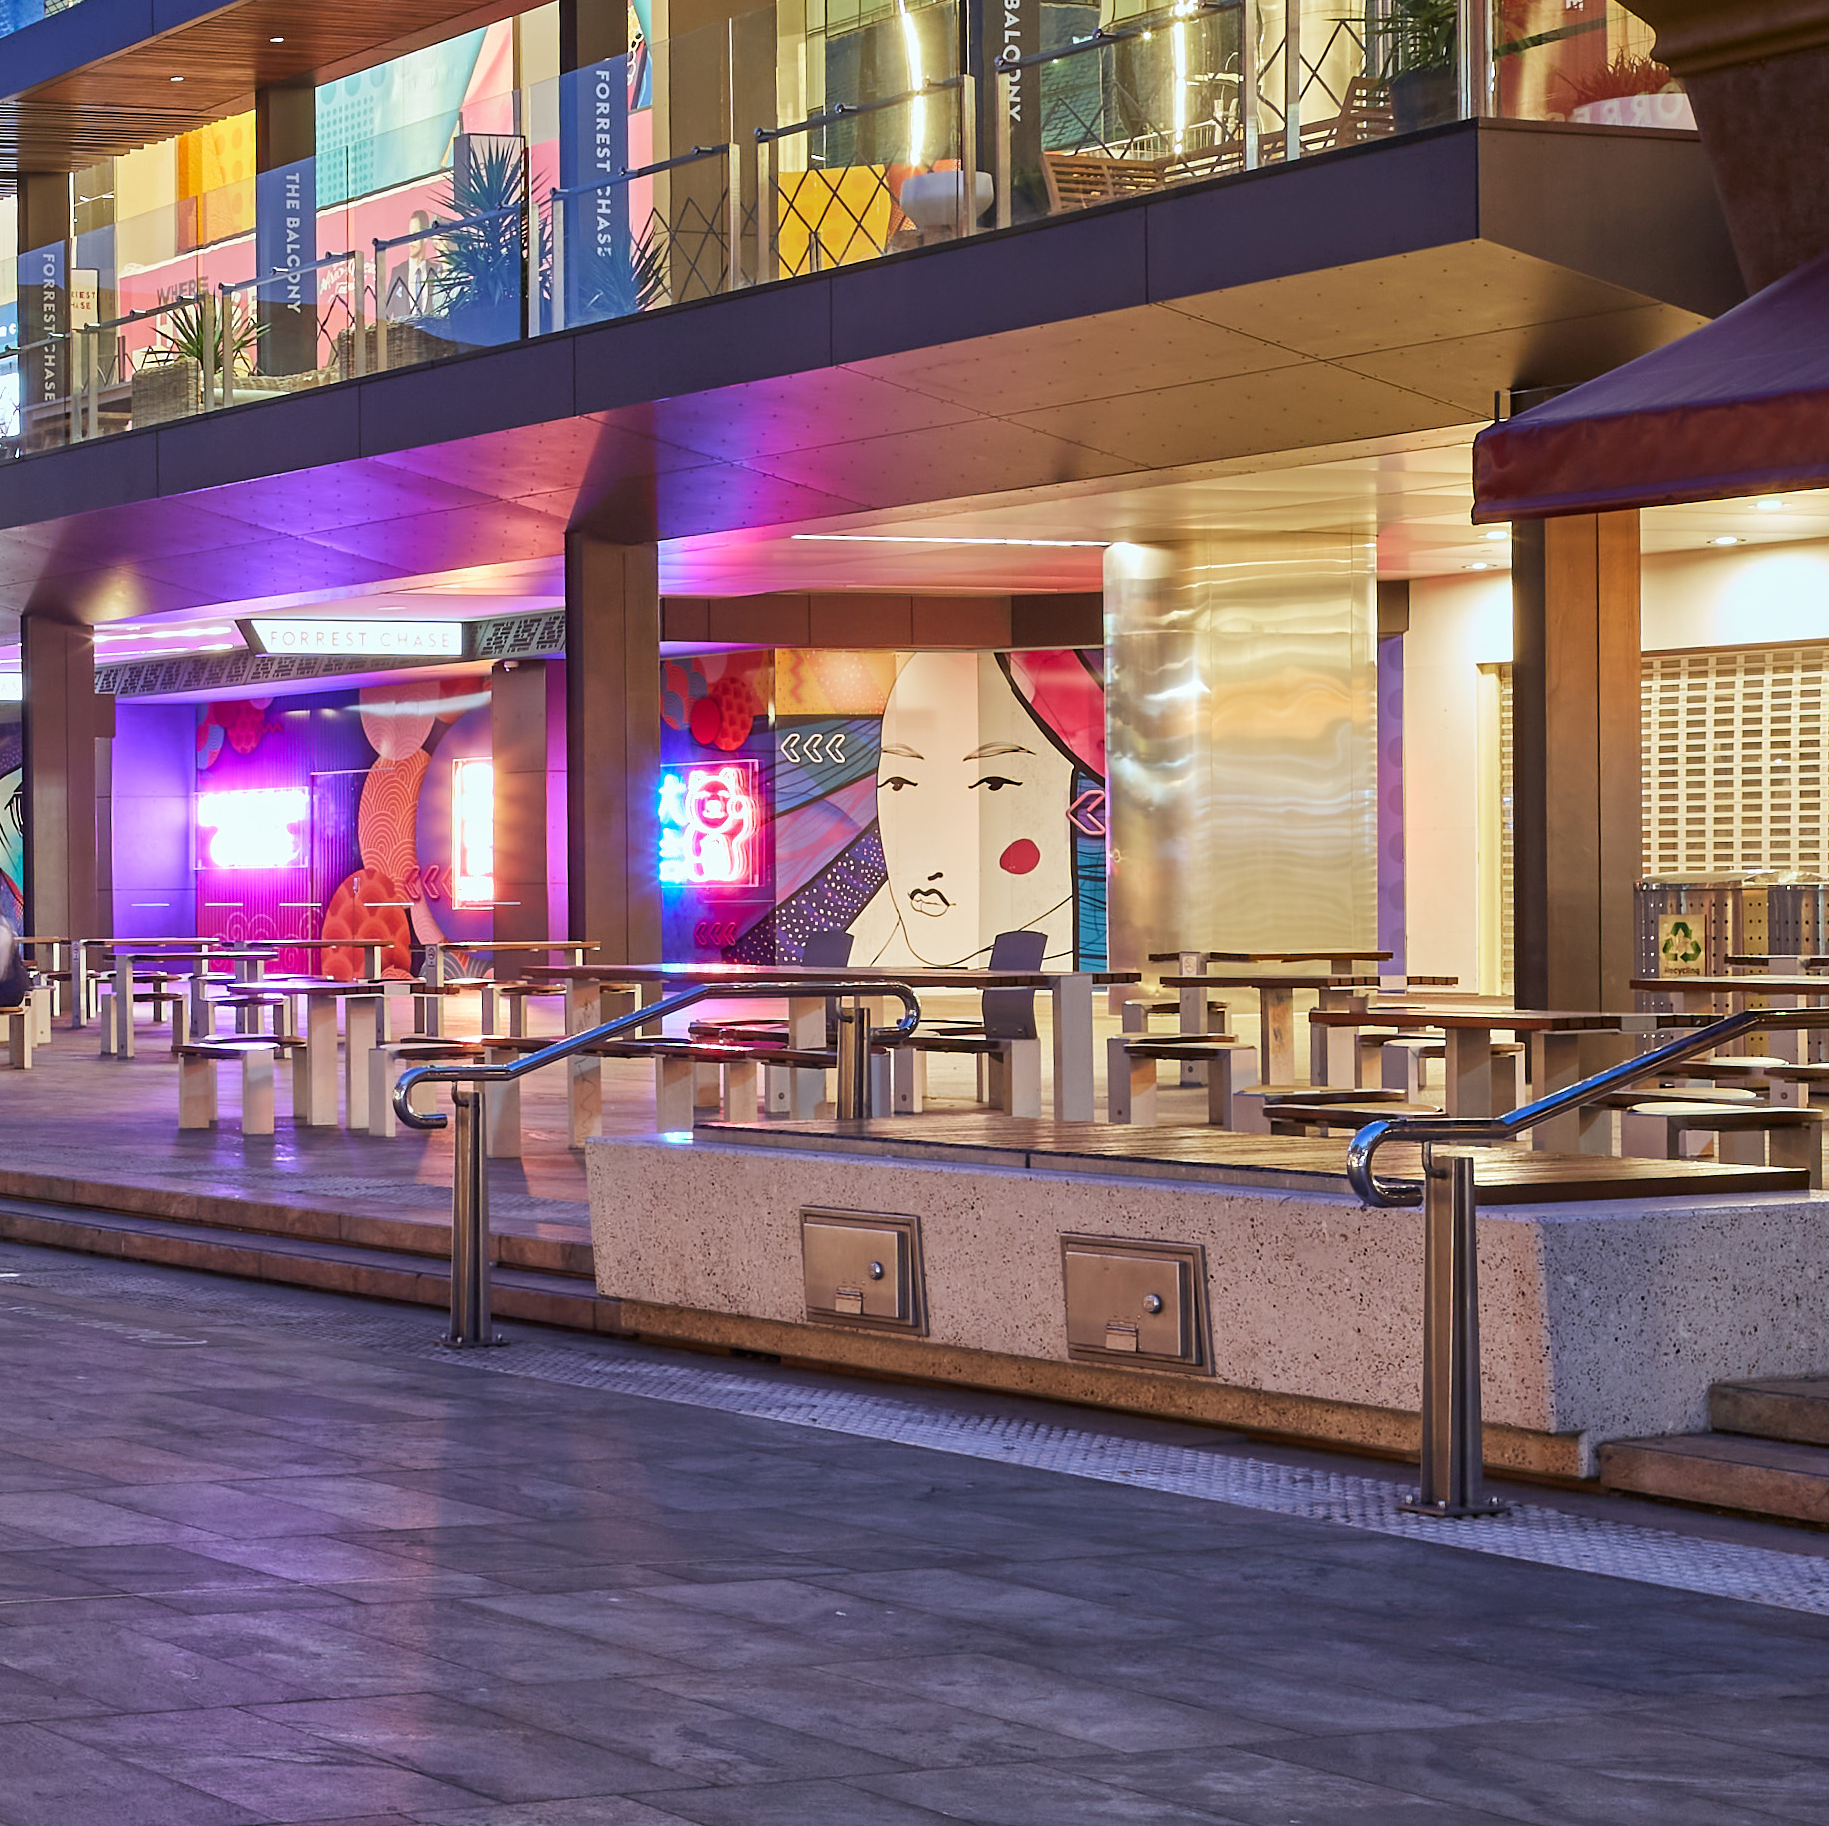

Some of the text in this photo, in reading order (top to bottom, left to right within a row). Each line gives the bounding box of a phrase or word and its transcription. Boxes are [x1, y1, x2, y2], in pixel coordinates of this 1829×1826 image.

[595, 70, 611, 173] FORREST
[286, 172, 300, 210] THE
[42, 254, 56, 334] FORREST
[270, 630, 449, 648] FORREST CHASE
